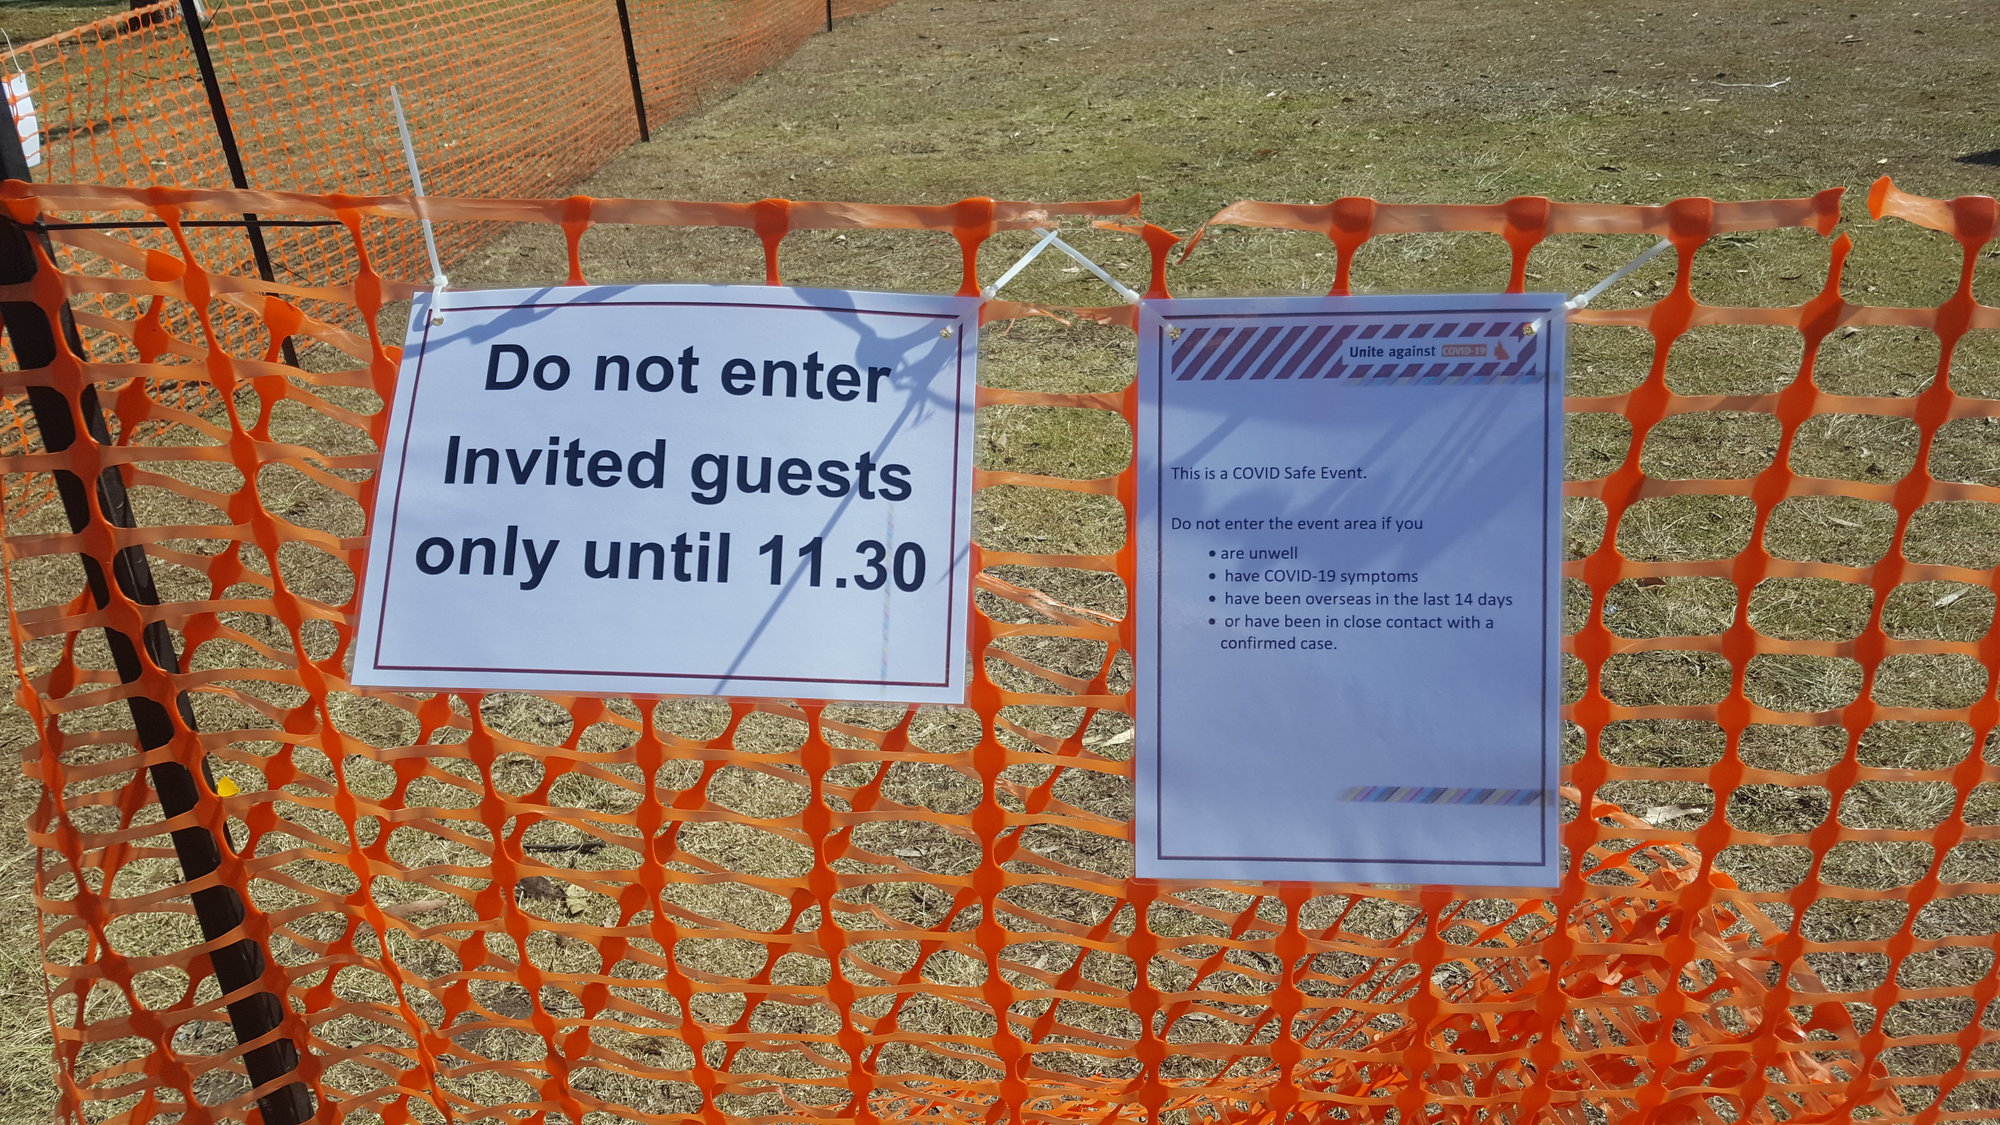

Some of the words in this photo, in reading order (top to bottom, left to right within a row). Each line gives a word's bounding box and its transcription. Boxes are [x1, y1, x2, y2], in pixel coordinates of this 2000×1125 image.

[1350, 346, 1383, 357] Unite
[1389, 345, 1435, 359] against
[1443, 346, 1487, 356] COVID-19
[486, 345, 570, 390] Do
[595, 346, 699, 393] not
[722, 352, 891, 402] enter
[445, 436, 665, 488] Invited
[692, 452, 911, 504] guests
[1171, 467, 1200, 479] This
[1205, 467, 1215, 480] is
[1220, 470, 1227, 479] a
[1233, 467, 1280, 479] COVID
[1284, 466, 1315, 479] Safe
[1321, 467, 1366, 479] Event.
[1172, 518, 1191, 530] Do
[1196, 519, 1220, 530] not
[1225, 518, 1264, 530] enter
[1269, 517, 1292, 529] the
[1298, 518, 1339, 529] event
[1344, 520, 1376, 529] area
[1382, 517, 1392, 529] if
[1396, 520, 1422, 532] you
[416, 526, 559, 590] only
[585, 532, 730, 582] until
[760, 535, 925, 592] 11.30
[1221, 550, 1244, 559] are
[1250, 546, 1297, 559] unwell
[1226, 569, 1259, 582] have
[1265, 570, 1335, 582] COVID-19
[1340, 571, 1418, 585] symptoms
[1226, 592, 1259, 605] have
[1265, 592, 1300, 605] been
[1306, 595, 1371, 605] overseas
[1376, 593, 1388, 605] in
[1394, 592, 1418, 605] the
[1424, 592, 1450, 605] last
[1455, 593, 1473, 605] 14
[1478, 593, 1512, 608] days
[1225, 618, 1240, 627] or
[1245, 614, 1279, 627] have
[1285, 614, 1320, 627] been
[1326, 615, 1338, 628] in
[1344, 614, 1381, 628] close
[1386, 617, 1442, 628] contact
[1447, 616, 1480, 628] with
[1486, 619, 1493, 629] a
[1221, 636, 1295, 649] confirmed
[1301, 640, 1337, 649] case.
